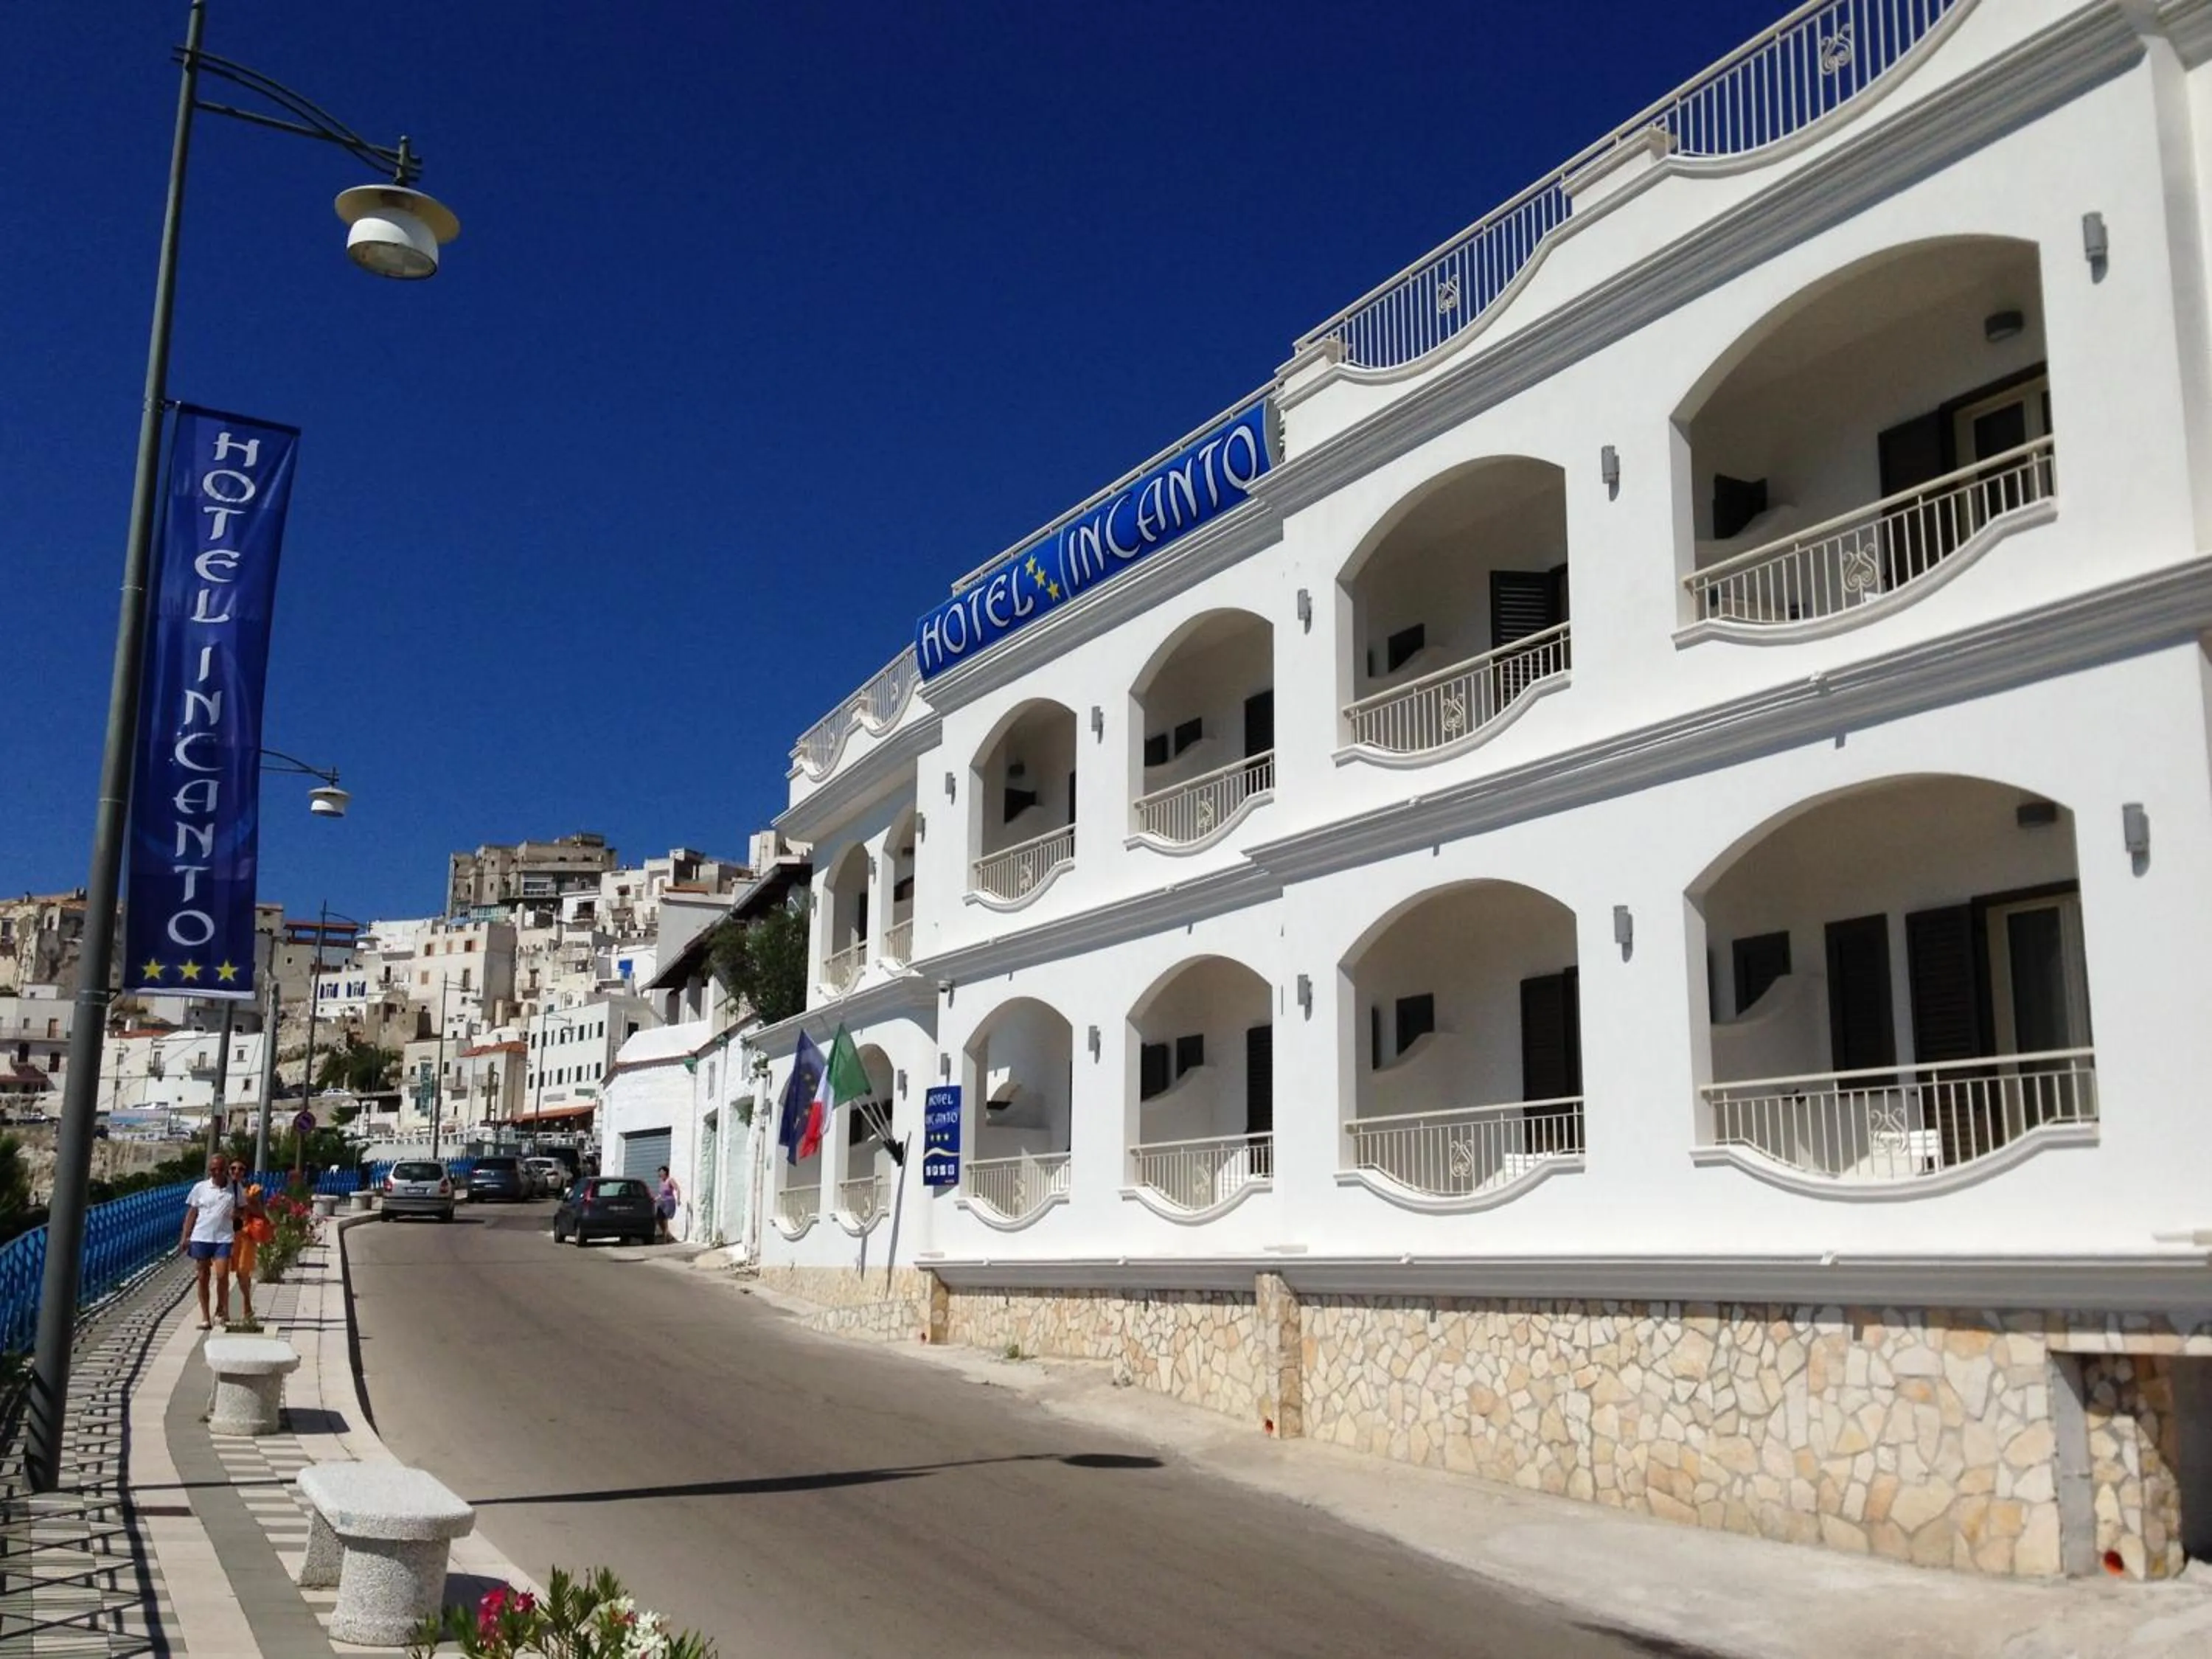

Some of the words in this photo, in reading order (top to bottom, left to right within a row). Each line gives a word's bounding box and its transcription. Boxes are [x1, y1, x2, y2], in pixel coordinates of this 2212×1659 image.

[189, 431, 260, 624] HOTEL
[921, 565, 1034, 670] HOTEL
[1067, 425, 1258, 586] INCANTO
[166, 646, 223, 947] INCANTO
